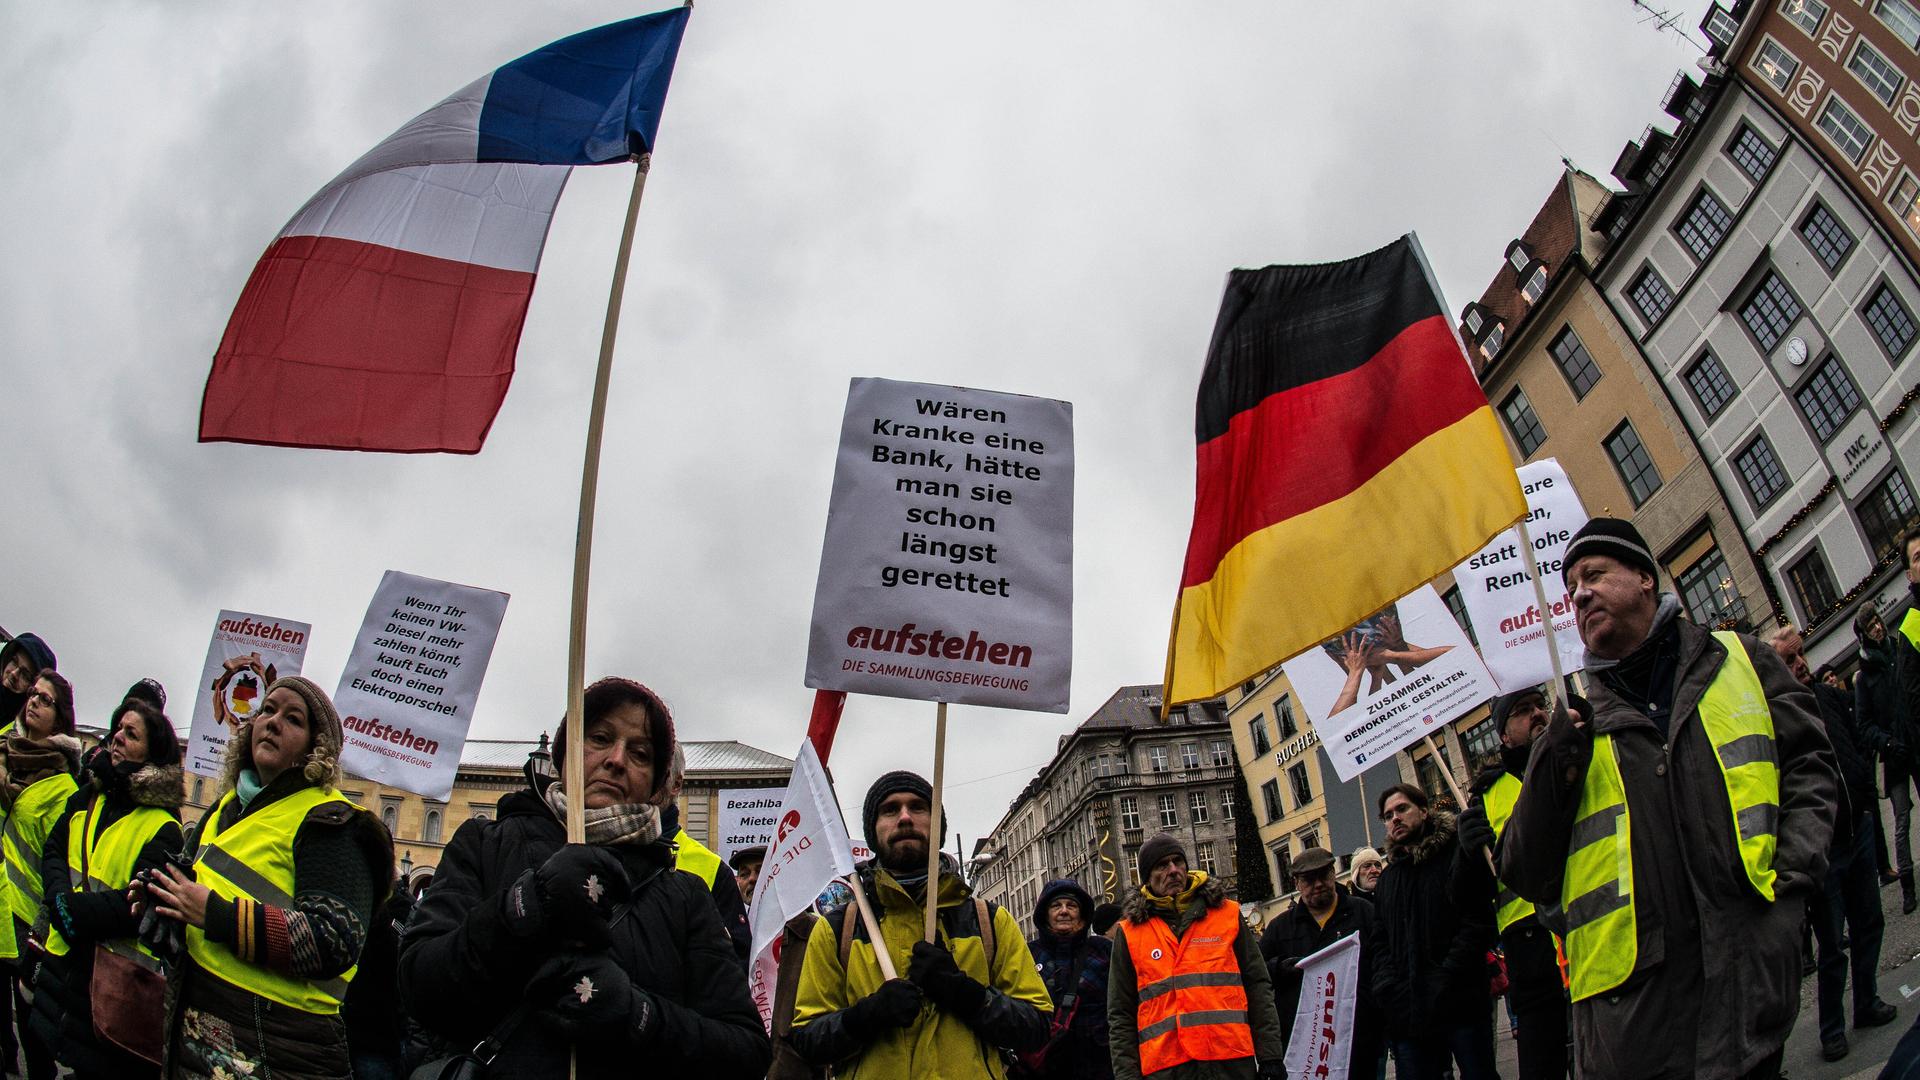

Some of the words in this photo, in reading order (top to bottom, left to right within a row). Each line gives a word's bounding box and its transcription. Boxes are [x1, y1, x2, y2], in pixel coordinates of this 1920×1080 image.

[915, 398, 1006, 423] Wären
[872, 418, 975, 445] Kranke
[984, 432, 1045, 455] eine
[1843, 434, 1869, 466] IWC
[871, 445, 953, 472] Bank,
[965, 453, 1041, 481] hätte
[895, 478, 960, 498] man
[970, 484, 1013, 505] sie
[906, 506, 995, 532] schon
[901, 532, 998, 564] längst
[1469, 544, 1518, 570] statt
[881, 565, 1010, 597] gerettet
[391, 608, 435, 627] keinen
[439, 619, 467, 633] VW-
[405, 596, 442, 613] Wenn
[443, 605, 466, 619] Ihr
[215, 633, 225, 642] DIE
[226, 634, 301, 655] SAMMLUNGSBEWEGUNG
[219, 617, 305, 645] aufstehen
[384, 623, 426, 641] Diesel
[427, 635, 465, 649] mehr
[846, 623, 1033, 668] aufstehen
[1505, 638, 1519, 649] DIE
[373, 637, 417, 655] zahlen
[419, 647, 462, 668] könnt,
[376, 652, 413, 672] kauft
[414, 662, 449, 680] Euch
[371, 668, 403, 685] doch
[405, 680, 445, 696] einen
[842, 658, 866, 673] DIE
[867, 660, 1029, 692] SAMMLUNGSBEWEGUNG
[351, 678, 458, 717] Elektroporsche!
[1344, 704, 1412, 743] DEMOKRATIE.
[1411, 670, 1468, 704] GESTALTEN.
[1366, 673, 1435, 715] ZUSAMMEN.
[343, 715, 440, 756] aufstehen
[1368, 739, 1394, 757] Aufstehen
[1393, 725, 1417, 741] München
[349, 737, 433, 769] SAMMLUNGSBEWEGUNG
[726, 834, 756, 844] statt
